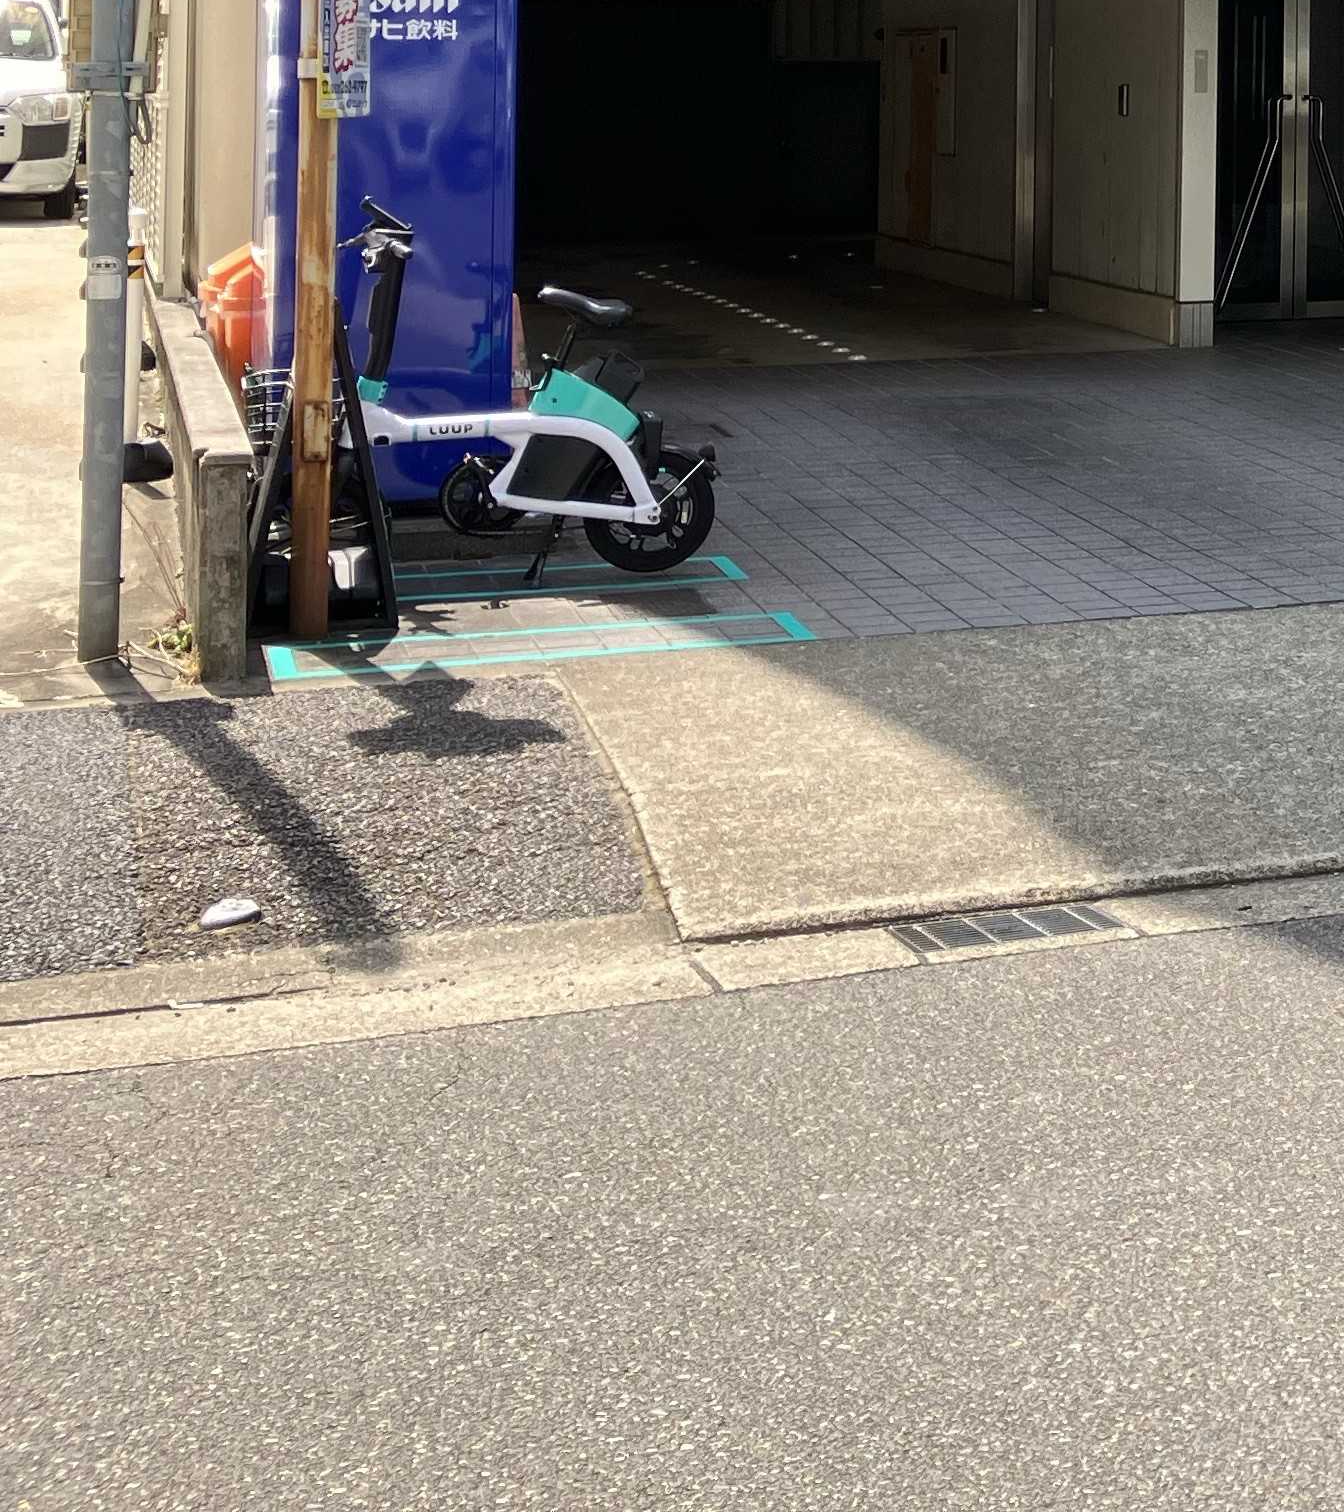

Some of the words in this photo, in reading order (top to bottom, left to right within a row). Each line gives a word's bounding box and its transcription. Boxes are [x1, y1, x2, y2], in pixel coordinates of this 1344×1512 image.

[370, 18, 458, 40] ヒ飲料
[430, 424, 473, 435] LUUP
